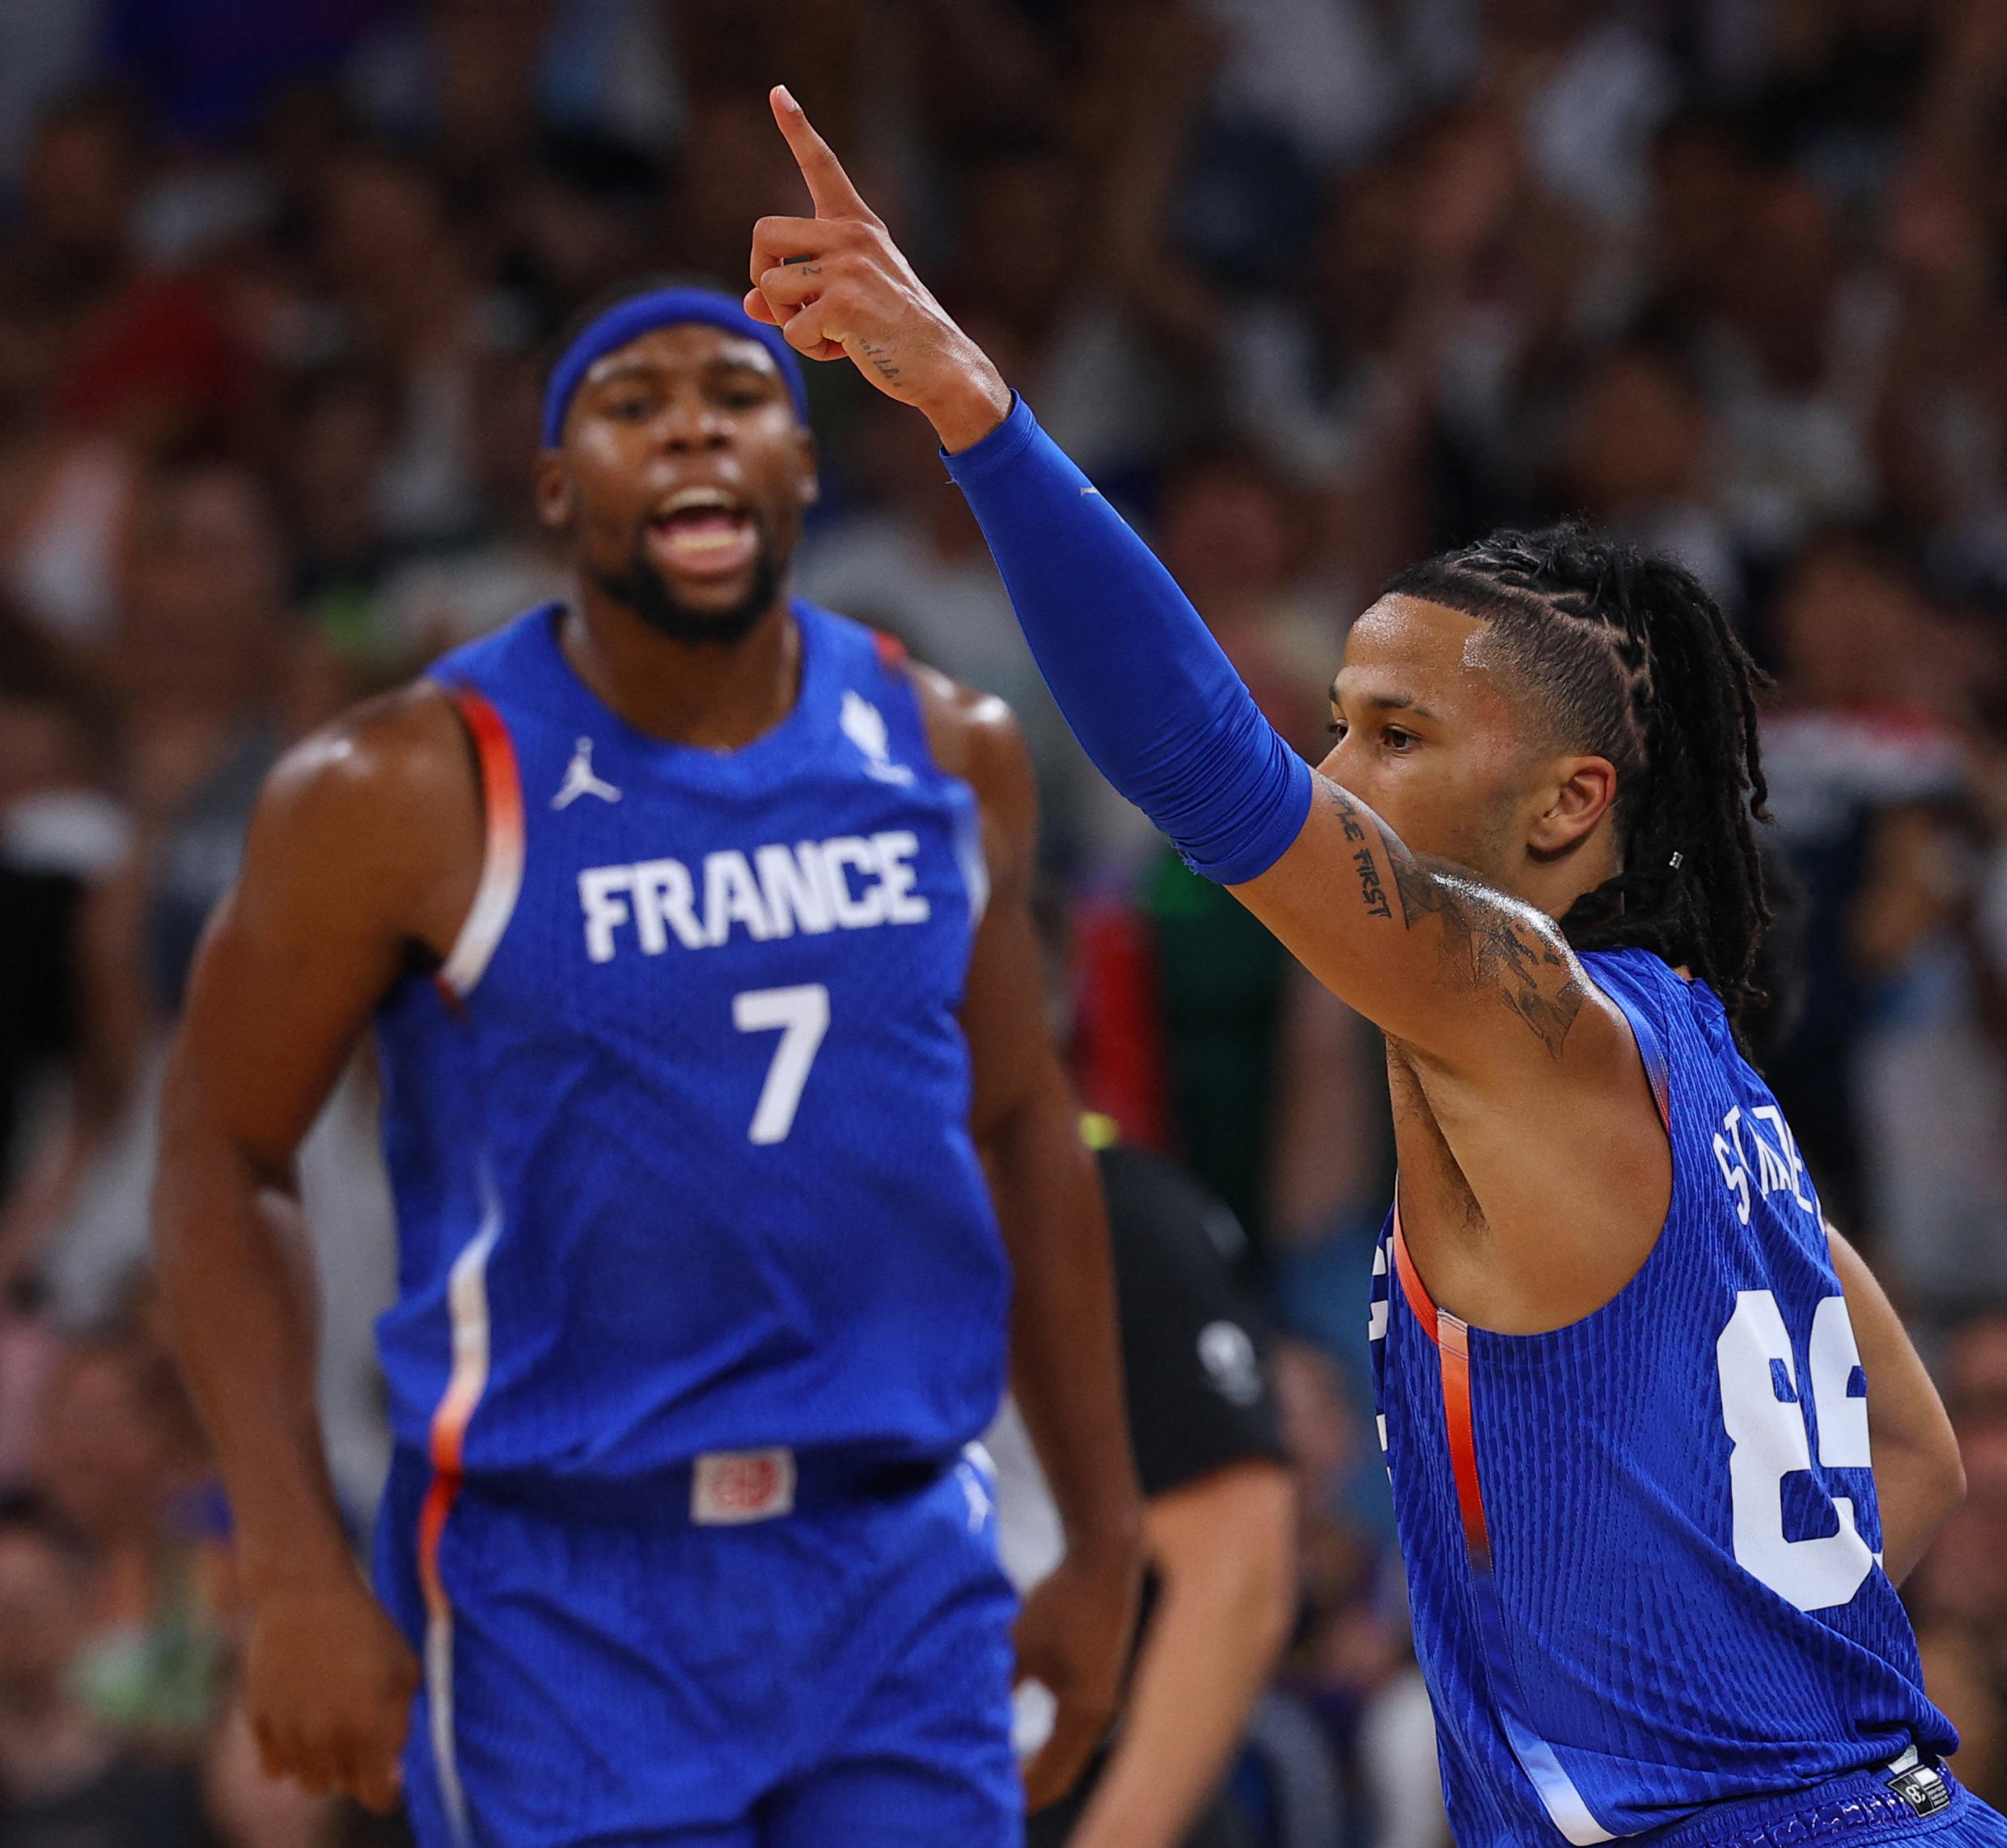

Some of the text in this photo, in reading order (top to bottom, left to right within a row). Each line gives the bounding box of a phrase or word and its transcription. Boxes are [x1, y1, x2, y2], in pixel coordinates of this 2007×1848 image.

[577, 830, 931, 964] FRANCE
[1353, 848, 1392, 920] FIRST
[732, 982, 832, 1147] 7
